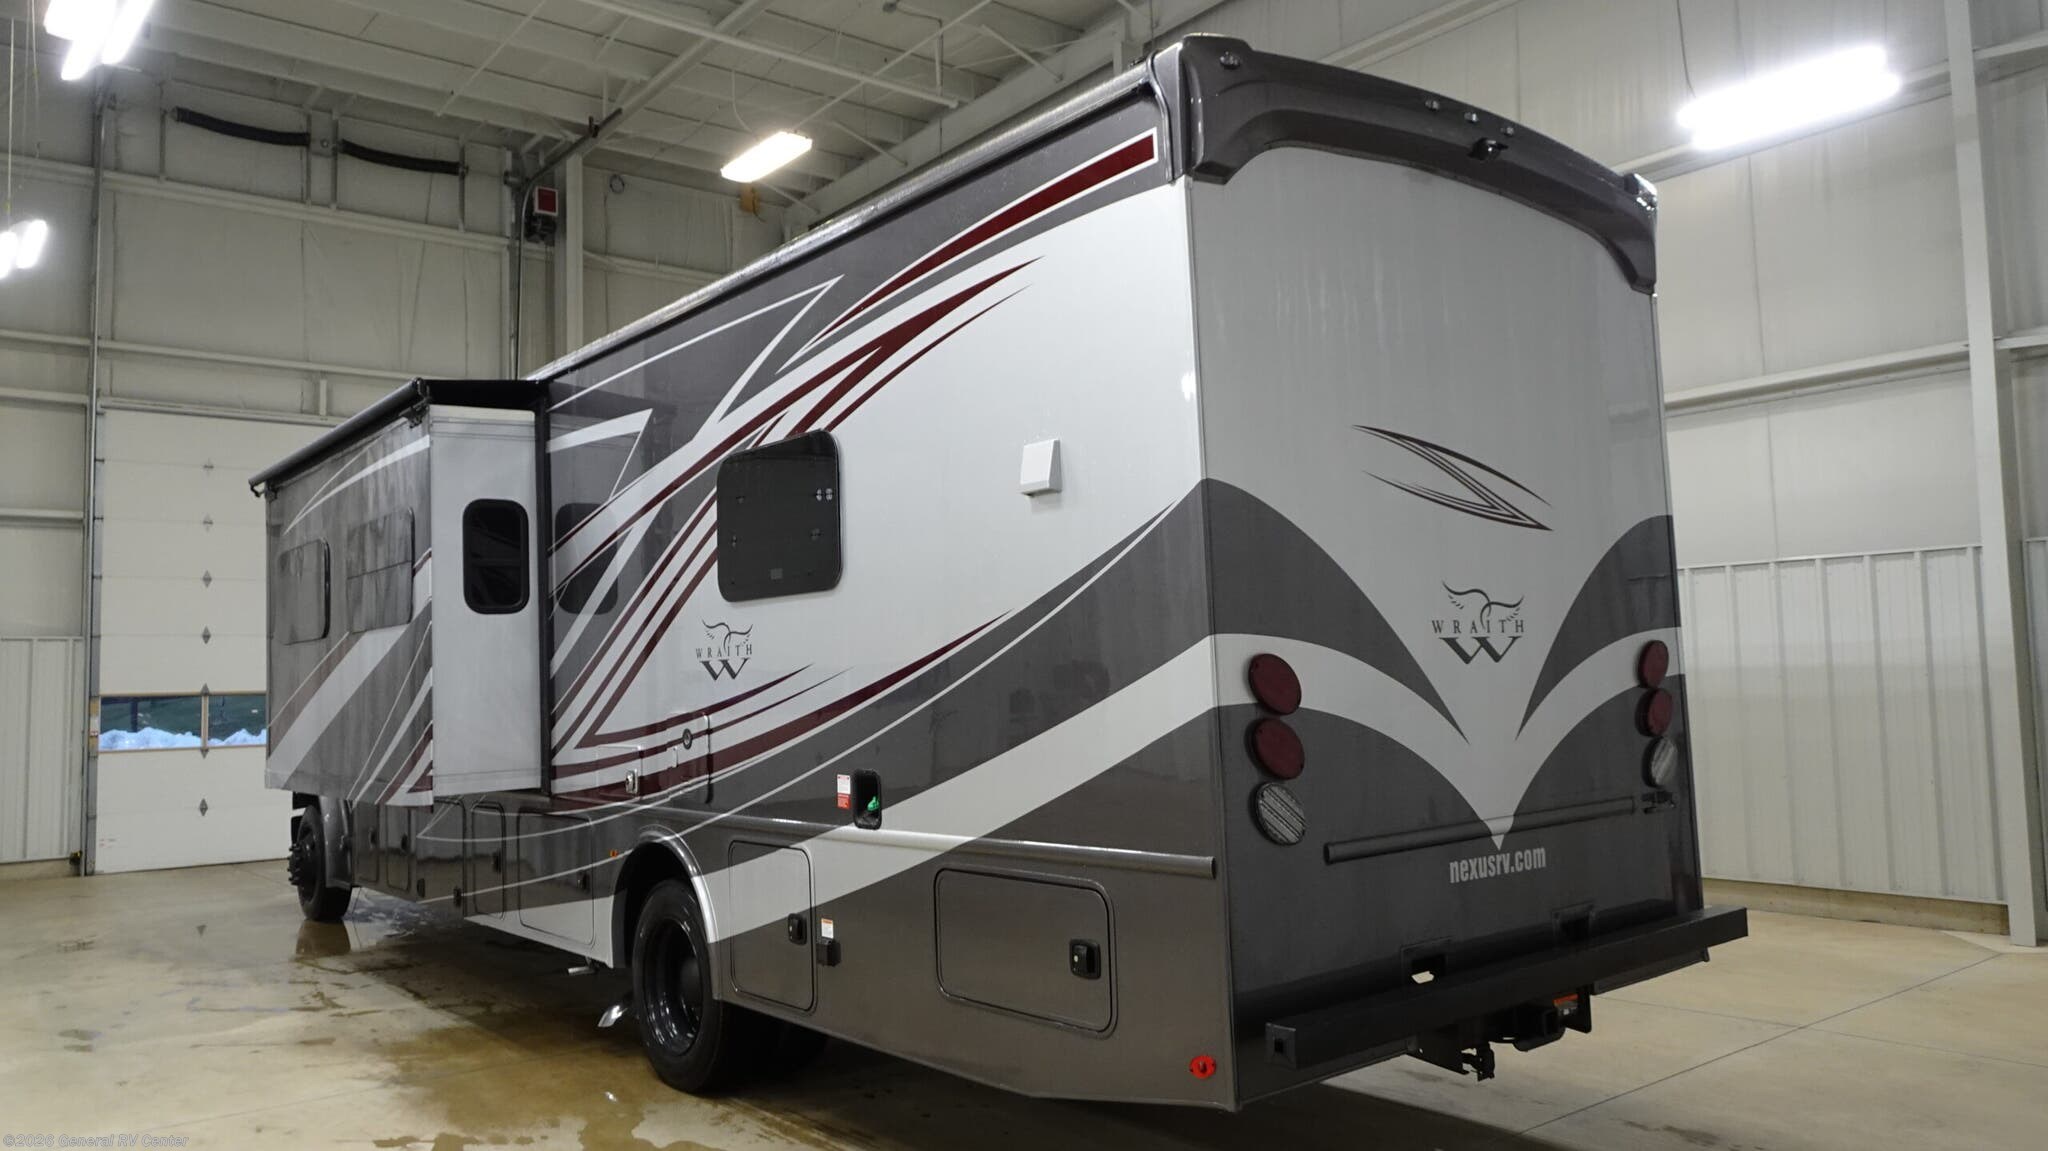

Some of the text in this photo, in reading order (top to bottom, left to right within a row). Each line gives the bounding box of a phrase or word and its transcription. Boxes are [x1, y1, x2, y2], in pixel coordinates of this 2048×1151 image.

[1431, 619, 1525, 634] WRAITH
[695, 644, 753, 659] WRAITH
[1449, 847, 1546, 884] nexusrv.com
